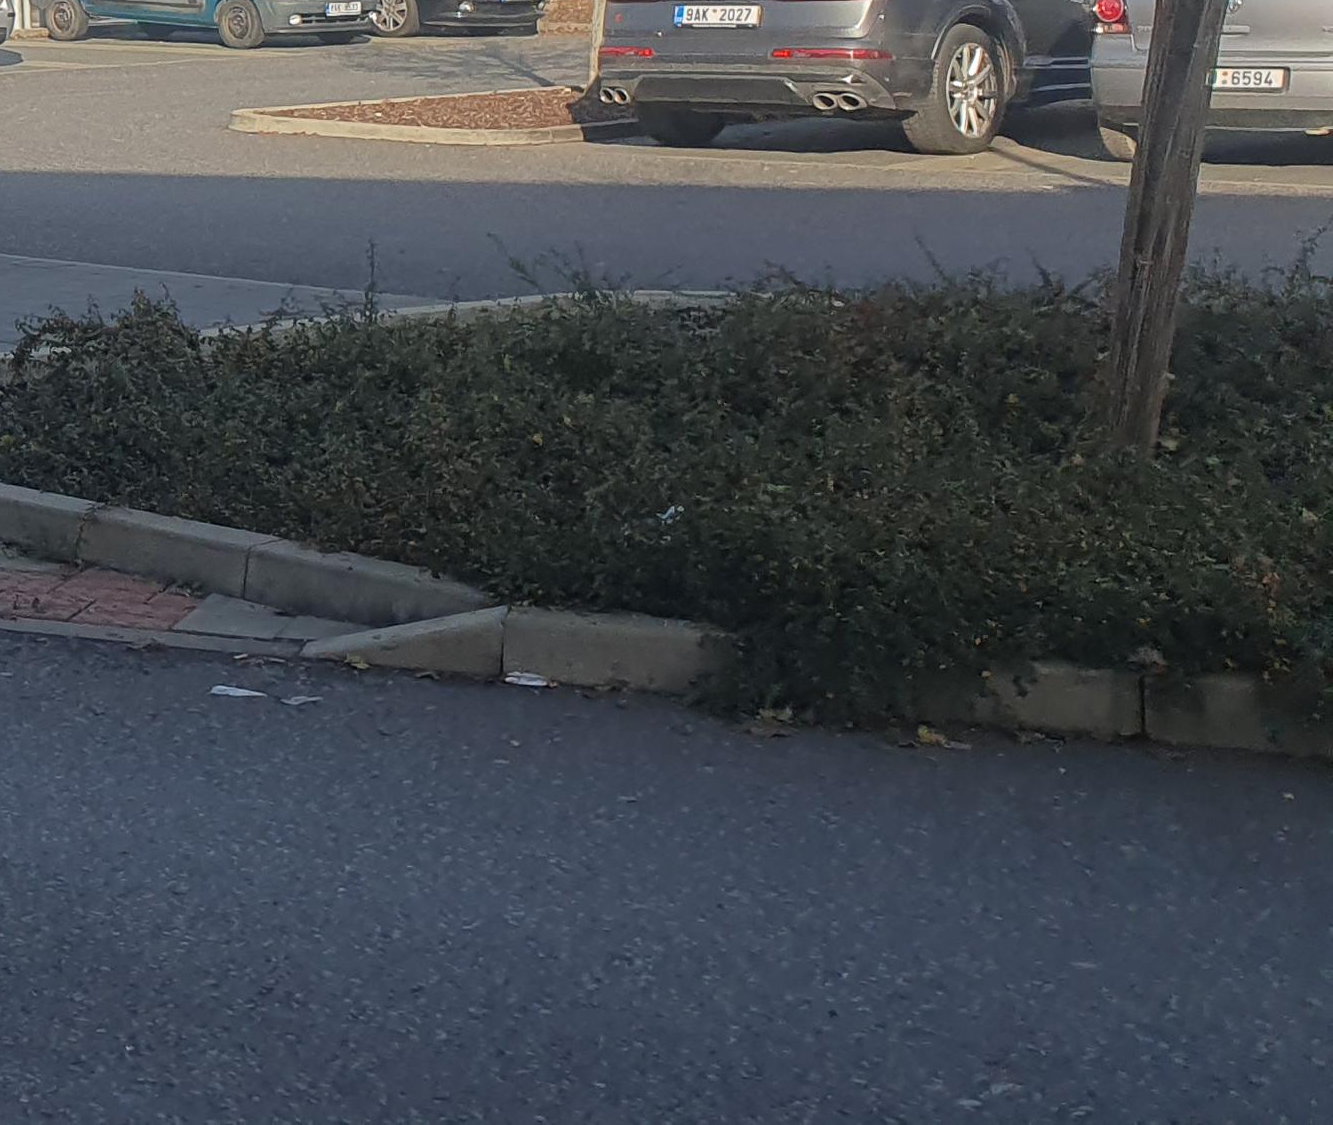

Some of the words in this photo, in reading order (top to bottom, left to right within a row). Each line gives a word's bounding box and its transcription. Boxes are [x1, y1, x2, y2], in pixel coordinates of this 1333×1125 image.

[686, 8, 710, 21] 9AK
[719, 8, 752, 21] 2027
[1231, 71, 1273, 86] 6594
